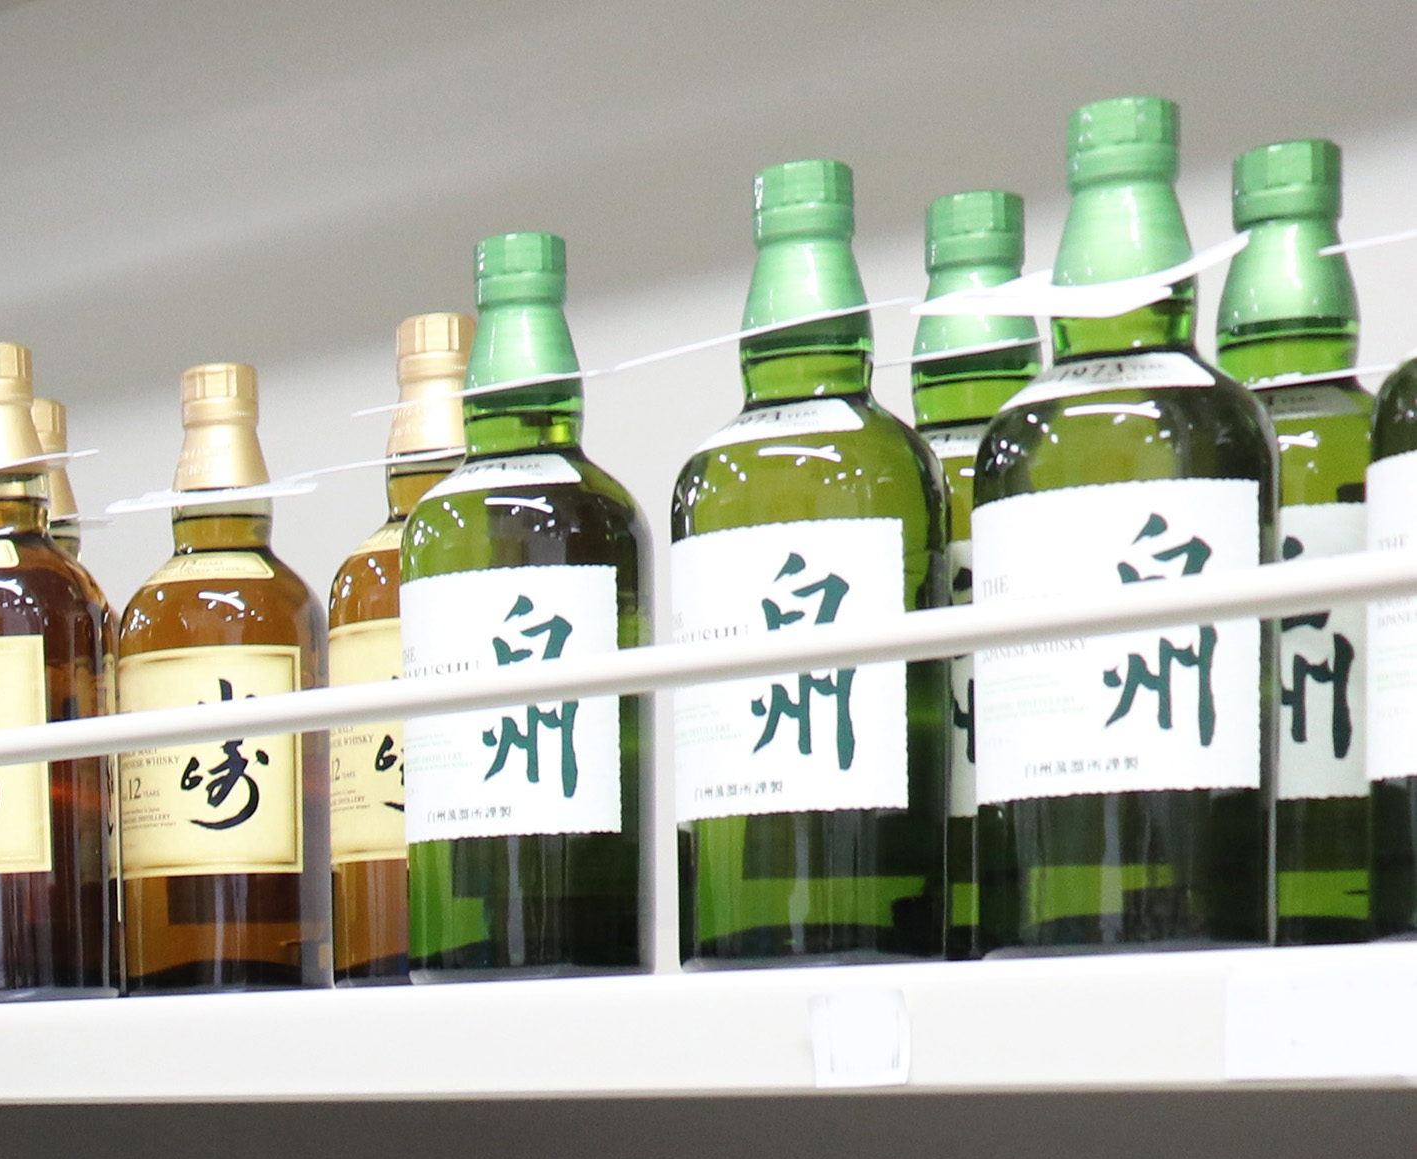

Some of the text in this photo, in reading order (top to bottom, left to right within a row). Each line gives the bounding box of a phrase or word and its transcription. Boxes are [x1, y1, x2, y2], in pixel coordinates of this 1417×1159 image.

[981, 574, 1010, 598] THE
[1101, 512, 1219, 748] 白州
[481, 594, 579, 799] 白州
[750, 551, 855, 772] 白州
[128, 777, 142, 801] 12
[145, 757, 180, 767] WHISKY
